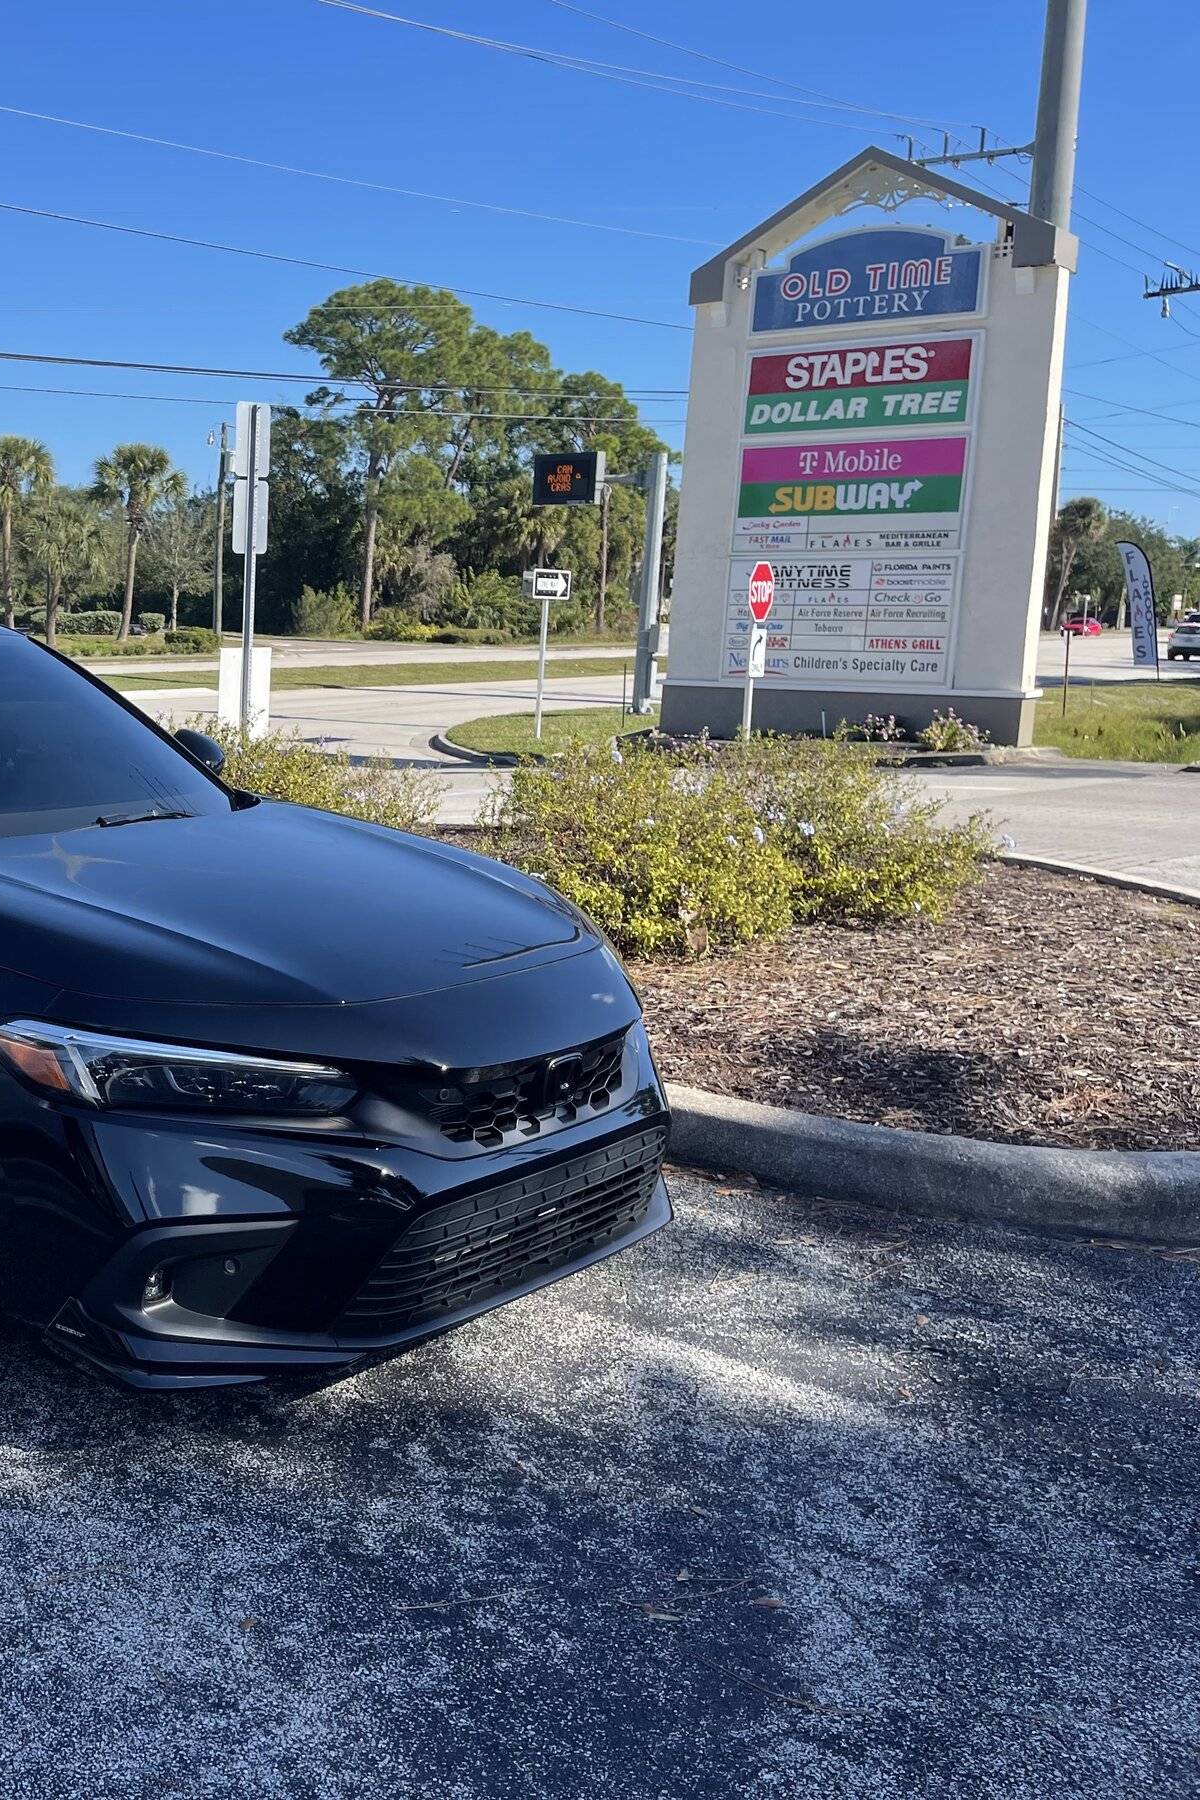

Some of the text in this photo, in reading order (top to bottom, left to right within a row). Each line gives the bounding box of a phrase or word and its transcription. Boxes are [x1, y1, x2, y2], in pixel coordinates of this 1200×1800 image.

[781, 256, 952, 300] OLD TIME
[795, 290, 929, 322] POTTERY
[785, 346, 929, 389] STAPLES
[750, 390, 962, 425] DOLLAR TREE
[825, 448, 902, 473] Mobile
[768, 479, 923, 514] SUBWAY
[751, 580, 773, 603] STOP
[874, 592, 910, 602] Check
[925, 592, 942, 602] Go
[798, 609, 863, 617] Air Force Reserve
[870, 609, 946, 620] Air Force Recruiting
[814, 623, 843, 632] Tobacco
[868, 639, 941, 650] ATHENS GRILL
[728, 652, 938, 674] Neurs Children's Specialty Care
